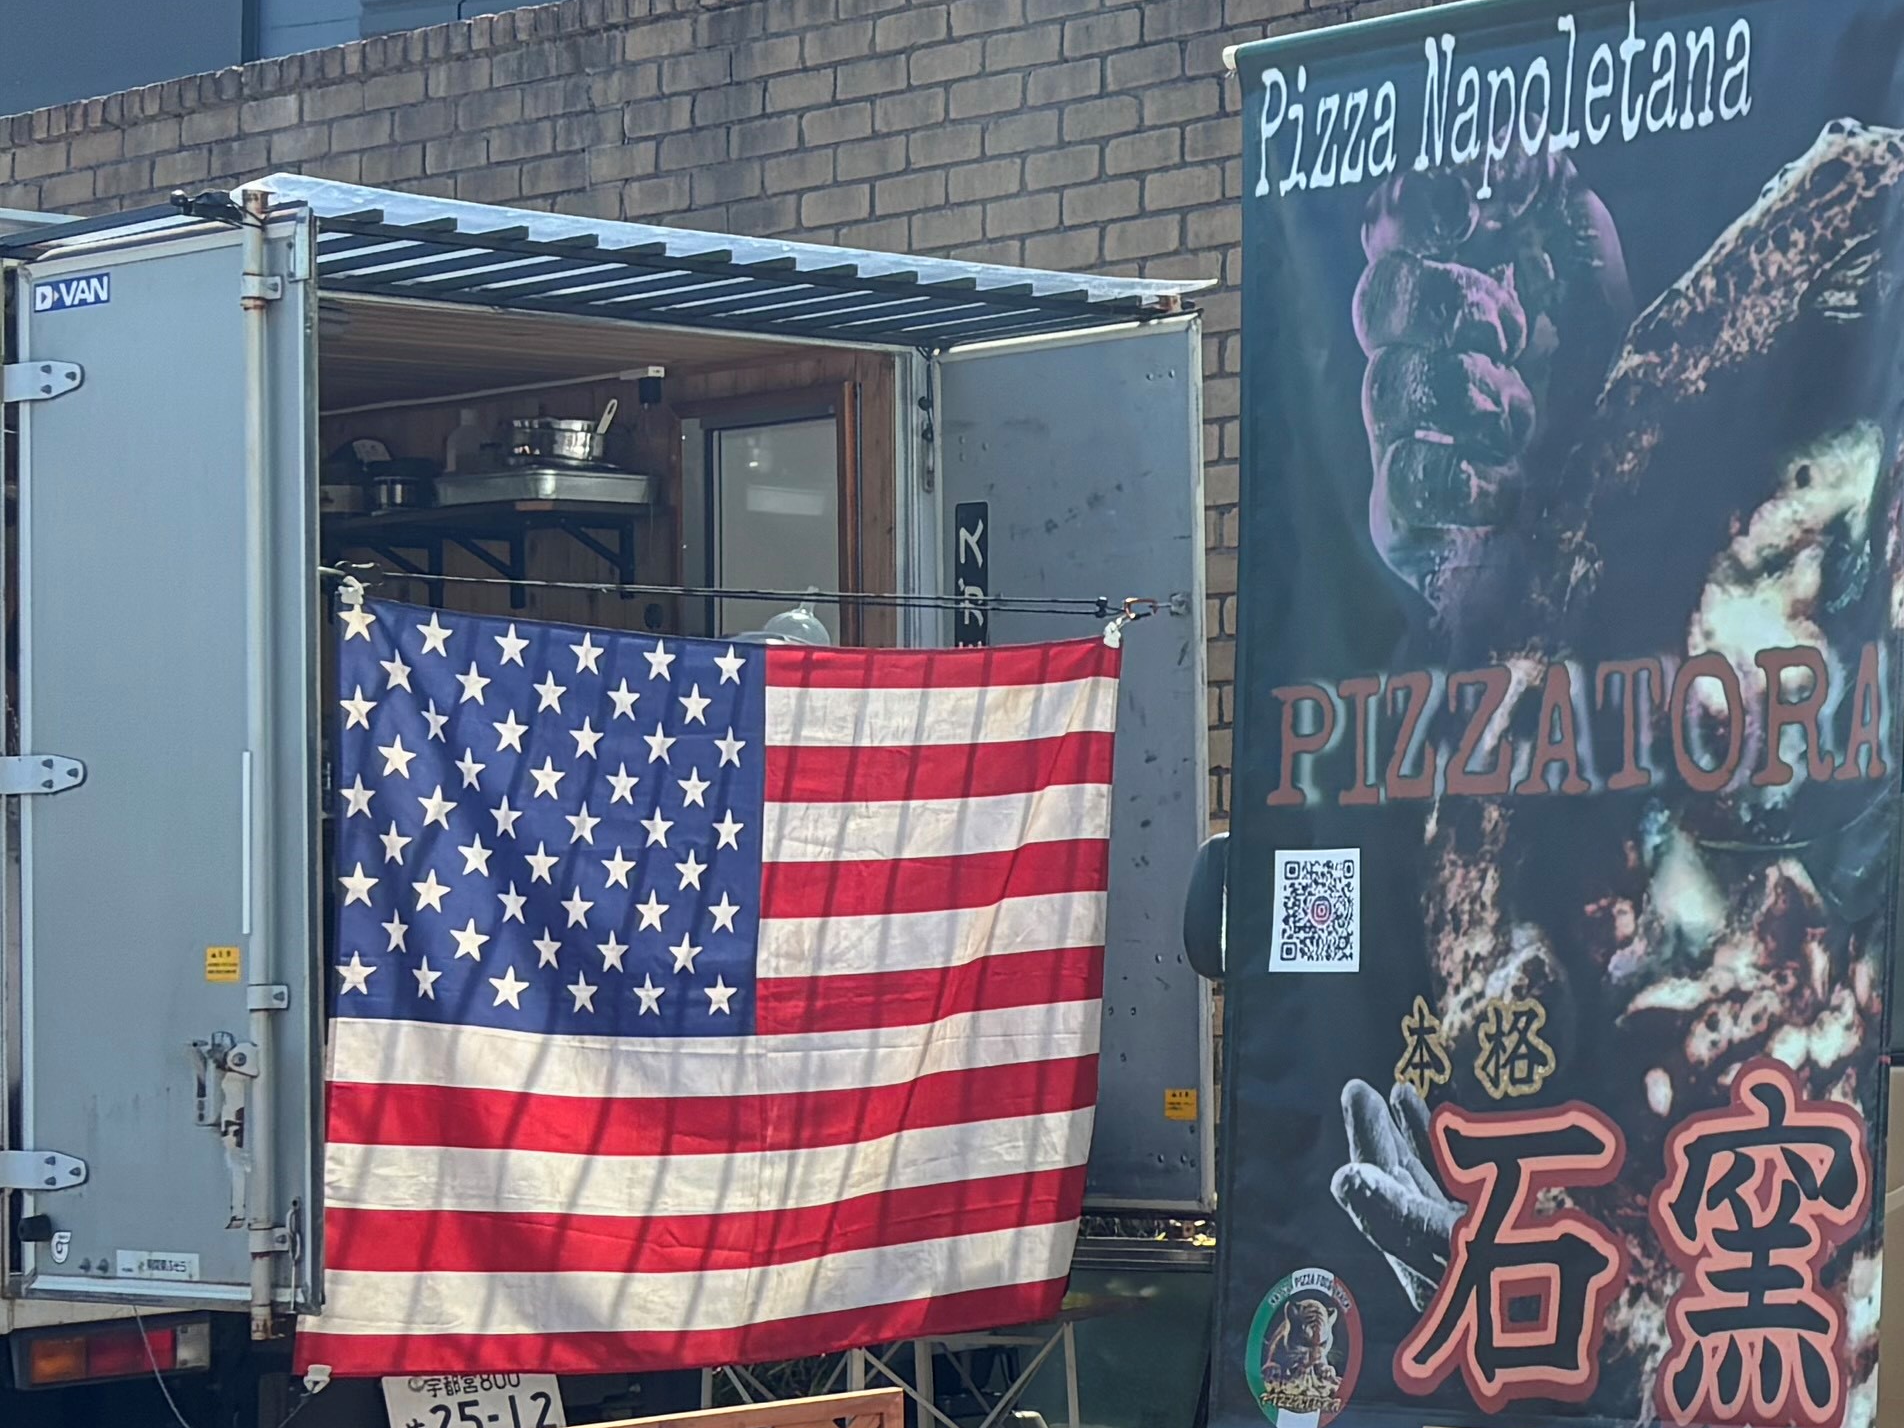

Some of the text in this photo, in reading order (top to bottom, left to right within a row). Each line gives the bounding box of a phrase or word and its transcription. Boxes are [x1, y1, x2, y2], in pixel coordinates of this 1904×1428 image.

[1254, 0, 1753, 200] Pizza Napoletana
[1268, 641, 1888, 807] PIZZATORA
[1396, 997, 1555, 1098] 本格
